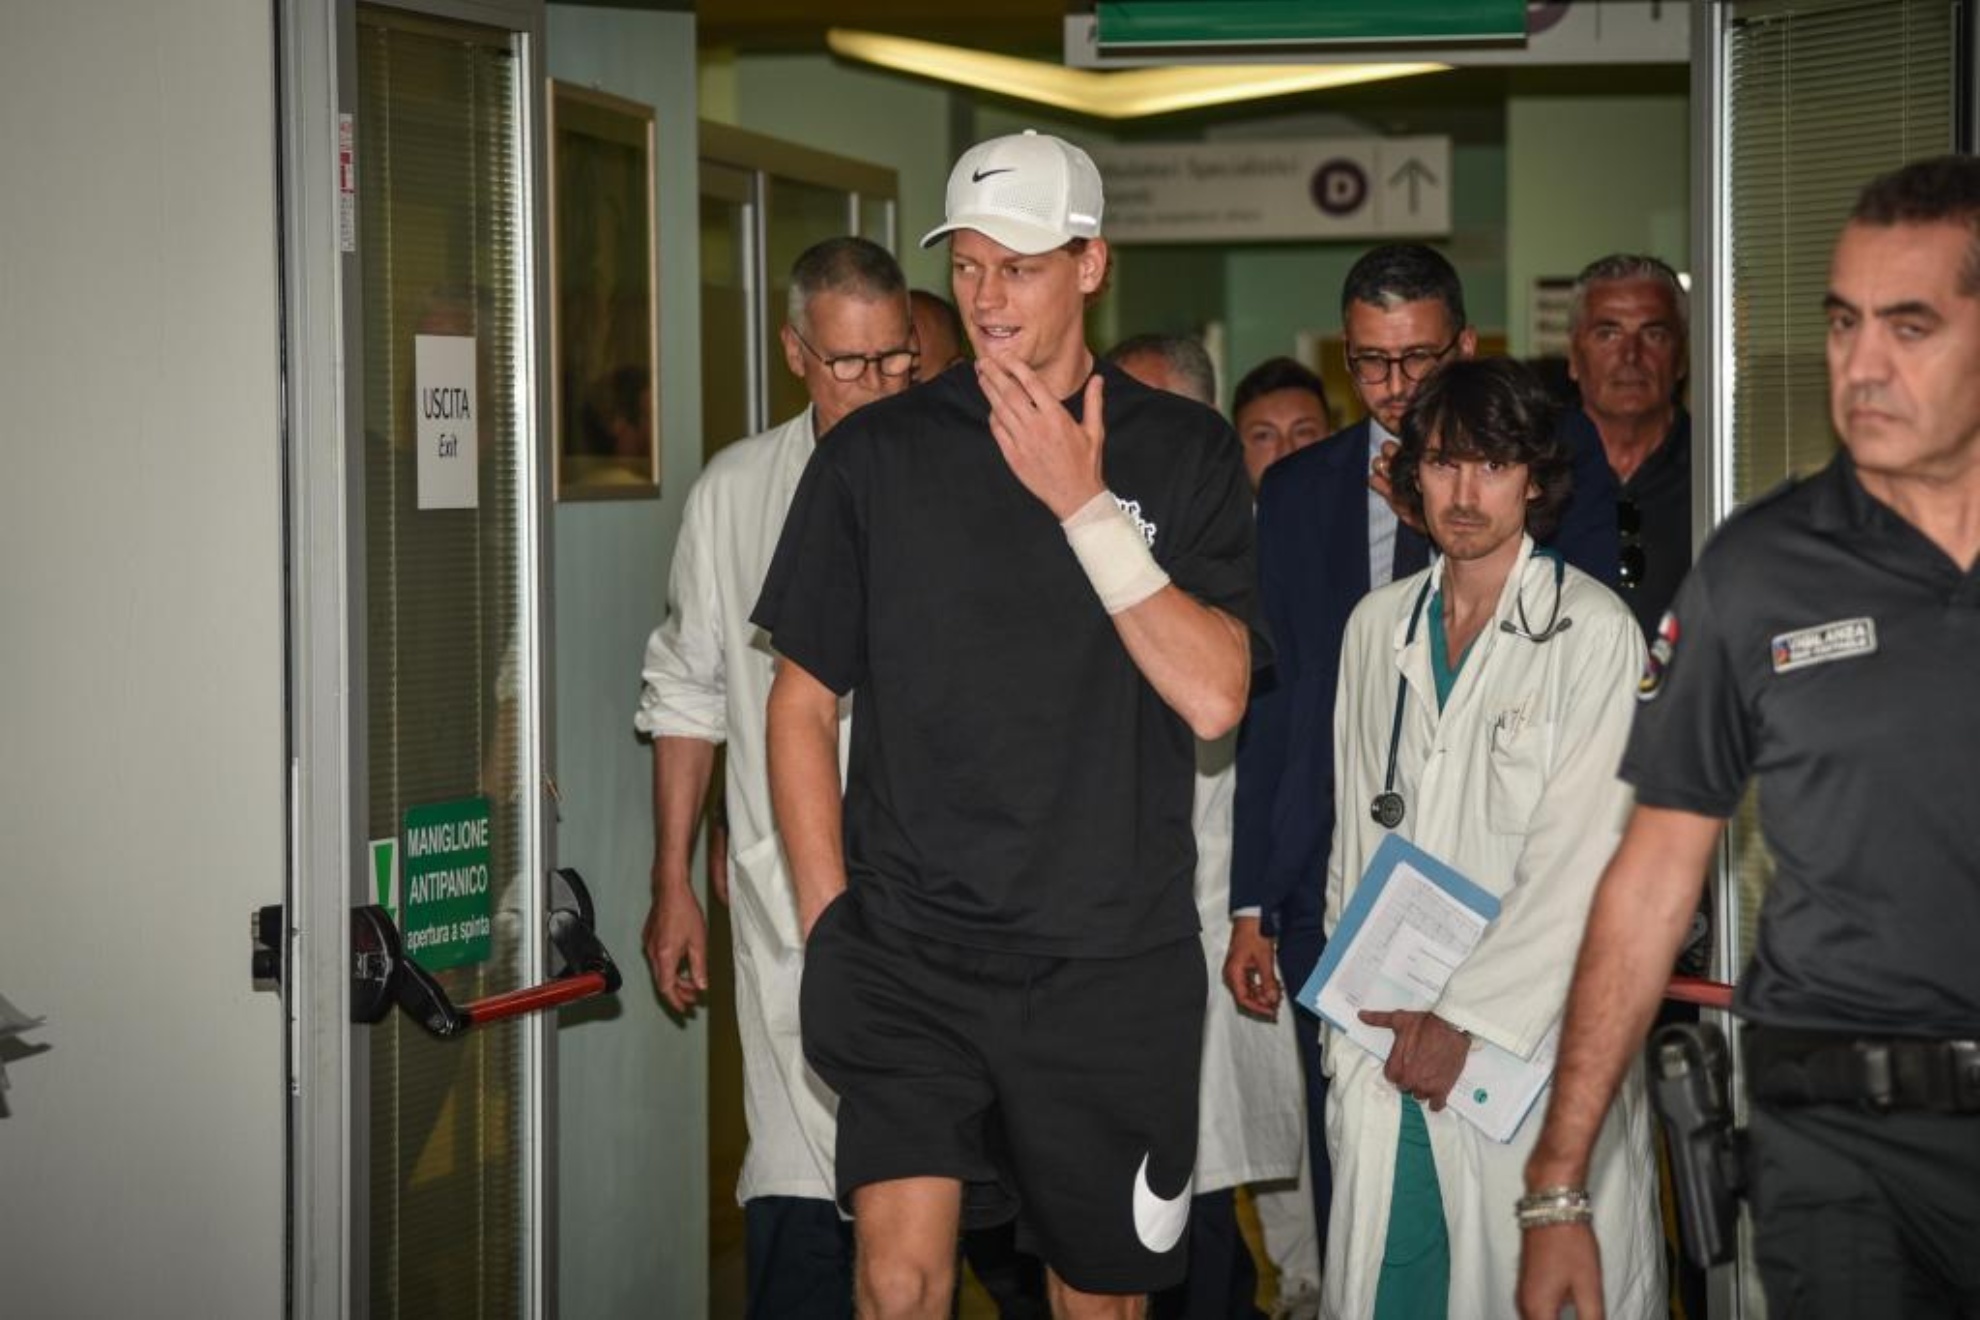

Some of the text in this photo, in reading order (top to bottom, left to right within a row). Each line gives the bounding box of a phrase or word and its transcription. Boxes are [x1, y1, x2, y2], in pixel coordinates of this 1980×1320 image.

[1326, 168, 1361, 205] D
[423, 387, 471, 419] USCITA
[439, 432, 457, 458] Exit
[407, 818, 489, 858] MANIGLIONE
[409, 864, 487, 905] ANTIPANICO
[407, 914, 490, 955] apertura a spinta
